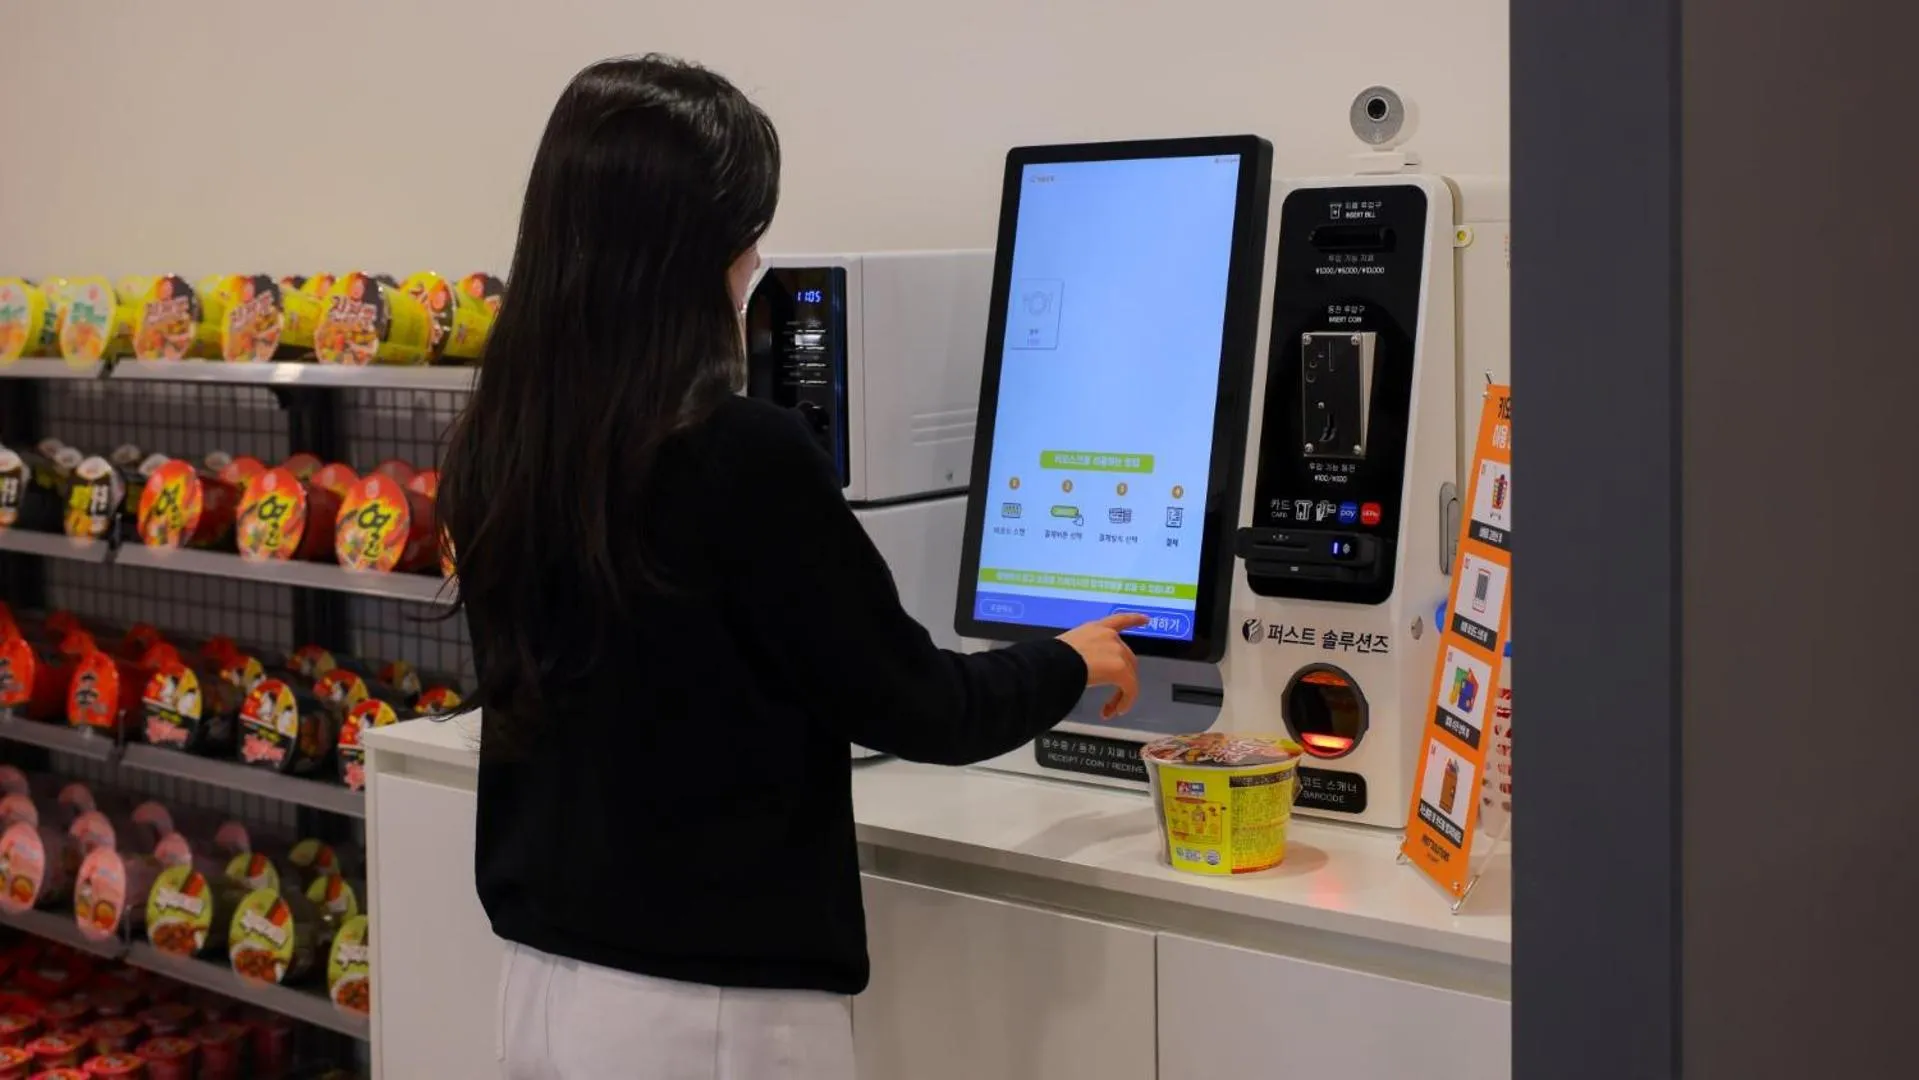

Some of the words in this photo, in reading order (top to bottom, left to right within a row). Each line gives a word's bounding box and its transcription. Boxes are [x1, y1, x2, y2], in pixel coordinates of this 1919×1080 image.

[1346, 211, 1364, 219] INSERT
[1270, 498, 1291, 510] 카드
[1340, 509, 1355, 519] pay
[1267, 623, 1316, 646] 퍼스트
[1322, 629, 1390, 654] 솔루션즈
[1042, 737, 1069, 751] 영수증
[1078, 743, 1096, 754] 동전
[1107, 746, 1125, 758] 지폐
[1048, 753, 1078, 765] RECEIPT
[1085, 758, 1104, 768] COIN
[1302, 776, 1321, 789] 코드
[1326, 780, 1357, 793] 스캐너
[1303, 790, 1345, 804] BARCODE
